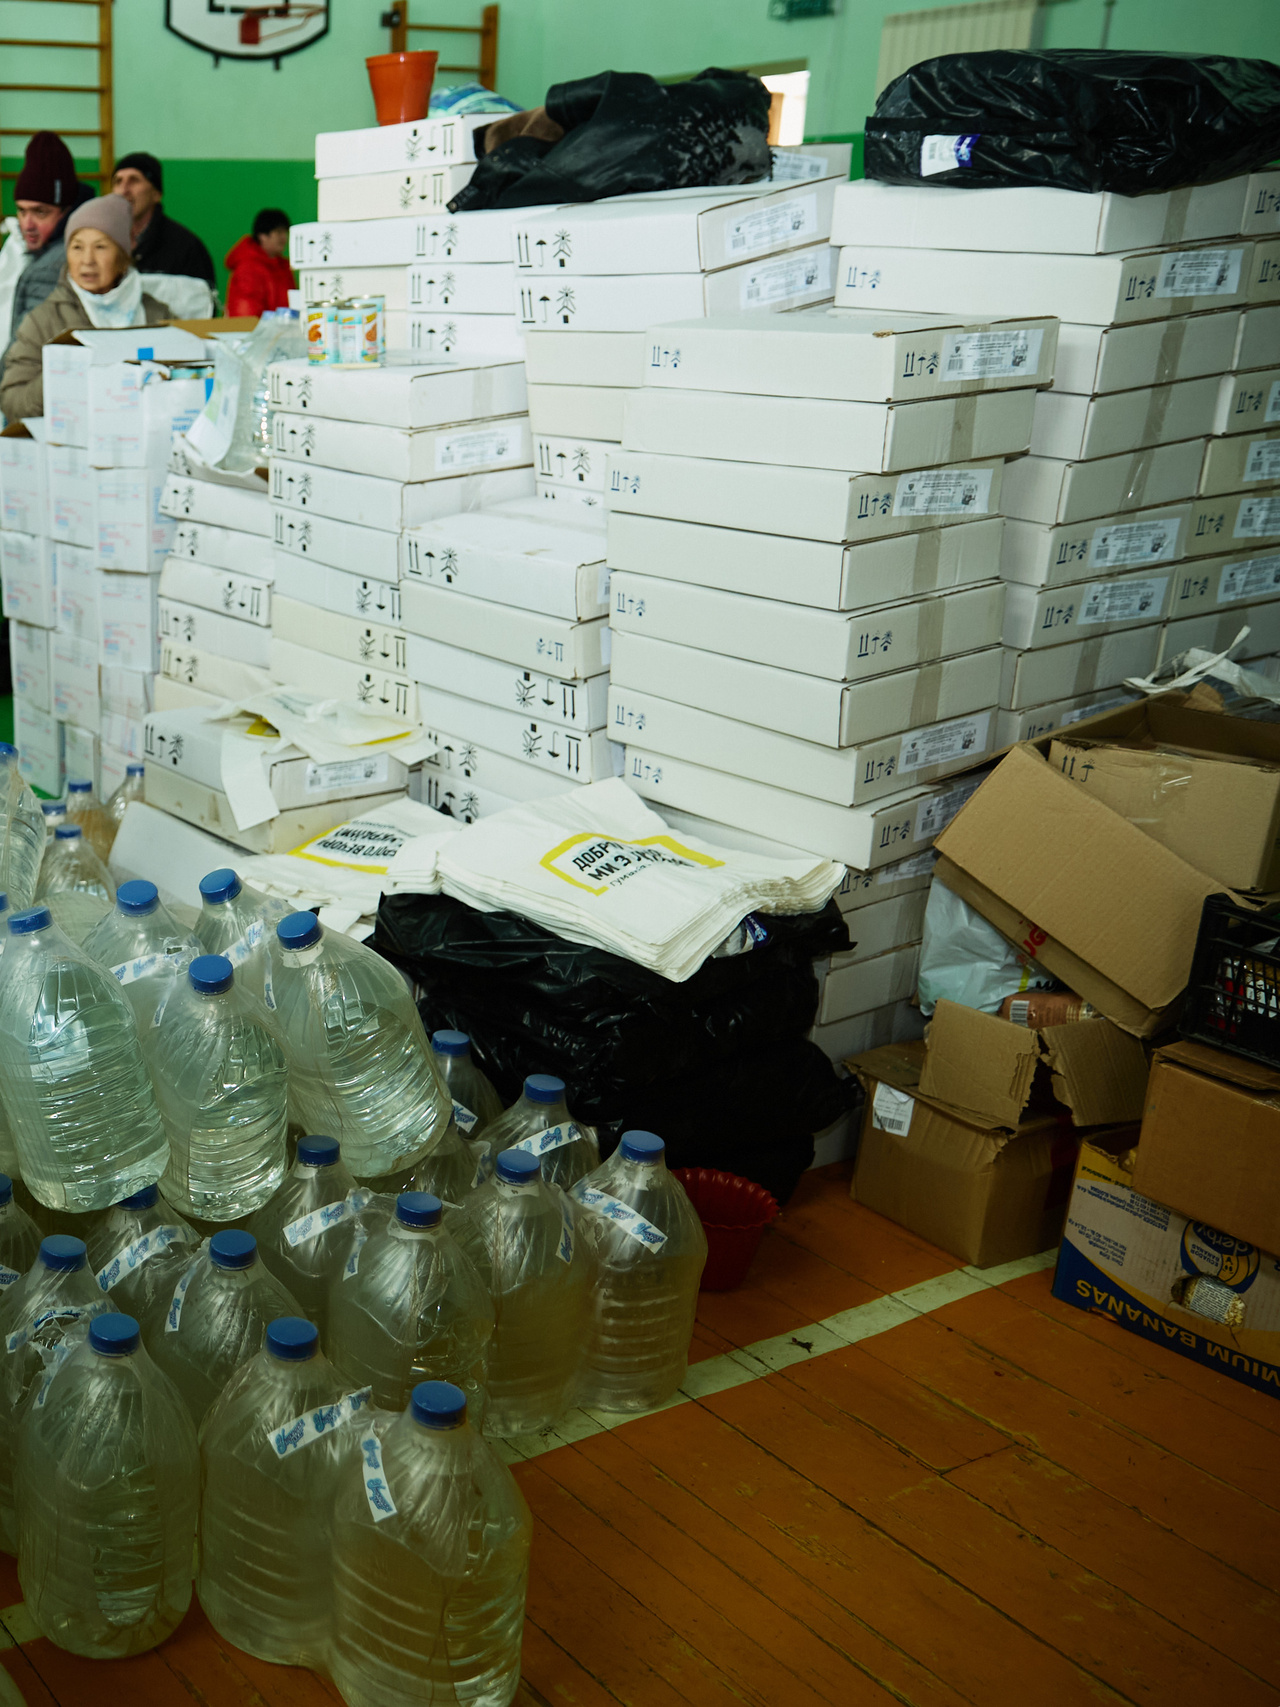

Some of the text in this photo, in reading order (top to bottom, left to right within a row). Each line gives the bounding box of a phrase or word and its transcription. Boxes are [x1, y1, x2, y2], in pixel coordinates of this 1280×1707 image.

[587, 862, 621, 881] МИ
[614, 854, 632, 867] З
[1076, 1278, 1197, 1349] BANANAS
